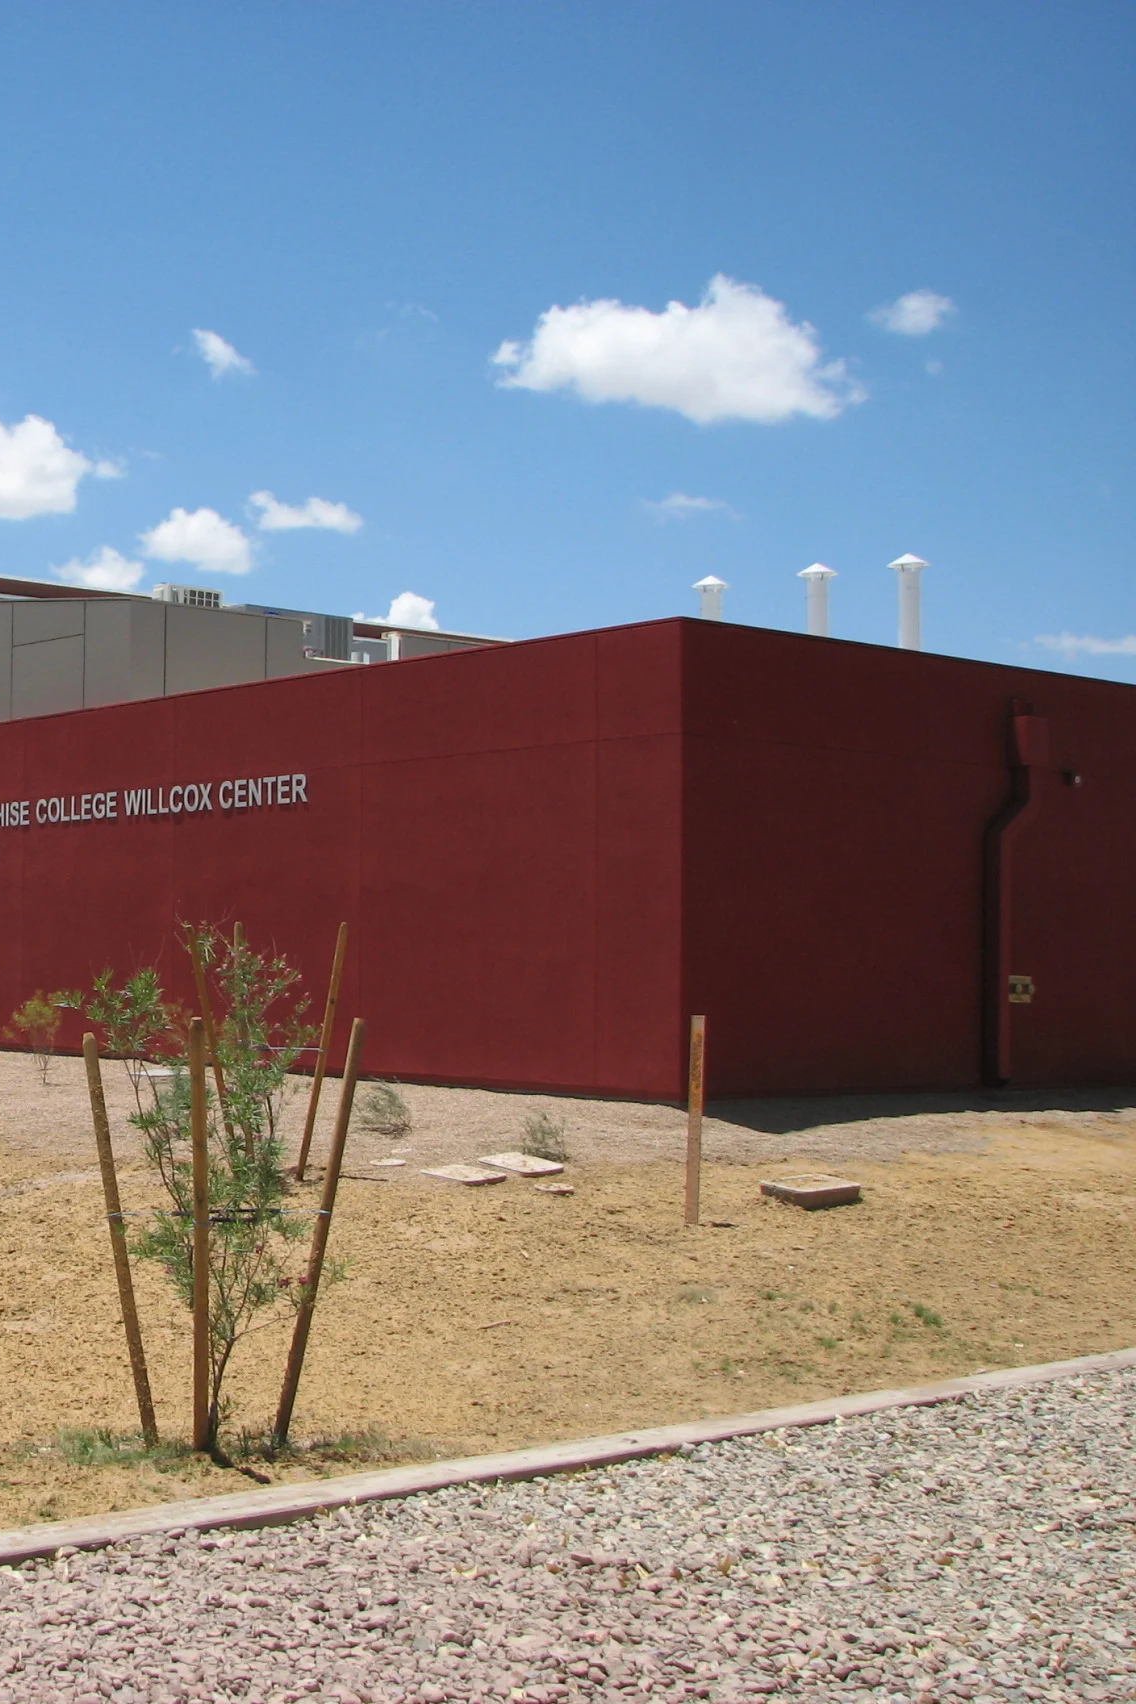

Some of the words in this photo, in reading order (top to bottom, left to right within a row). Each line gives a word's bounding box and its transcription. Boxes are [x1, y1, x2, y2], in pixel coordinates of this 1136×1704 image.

[35, 792, 118, 824] COLLEGE
[124, 783, 213, 816] WILLCOX
[218, 773, 308, 809] CENTER
